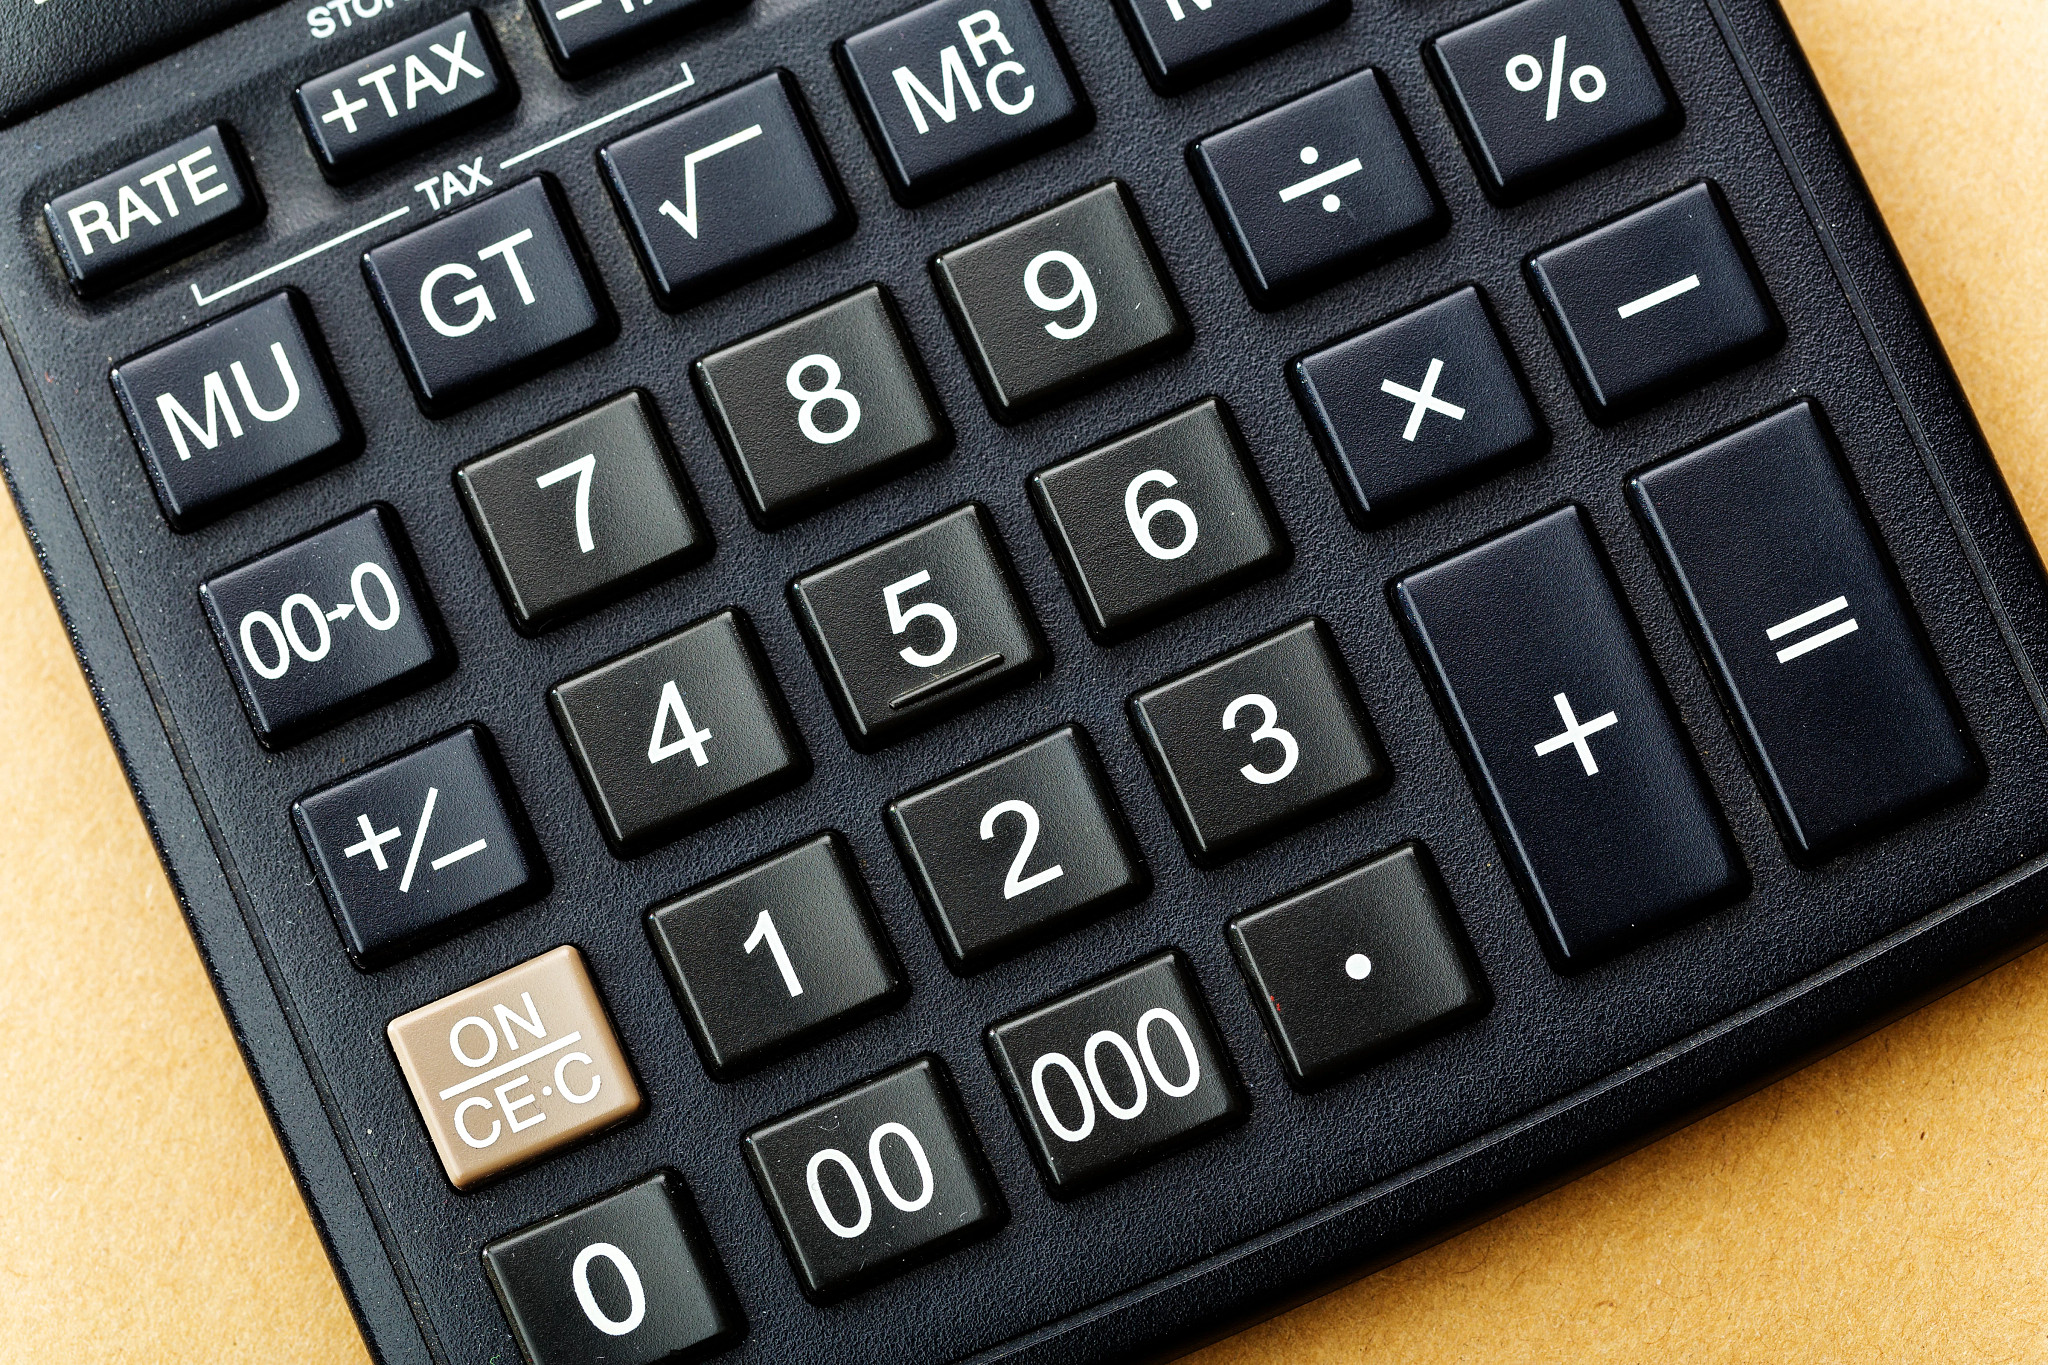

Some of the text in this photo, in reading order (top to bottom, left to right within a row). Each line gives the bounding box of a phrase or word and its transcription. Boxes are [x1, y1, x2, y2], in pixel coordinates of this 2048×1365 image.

[321, 30, 485, 135] +TAX
[67, 144, 229, 257] RATE
[413, 155, 494, 212] TAX
[419, 227, 537, 339] GT
[1023, 250, 1098, 340] 9
[155, 341, 302, 461] MU
[786, 353, 861, 445] 8
[535, 453, 597, 554] 7
[1124, 469, 1199, 560] 6
[882, 569, 958, 668] 5
[647, 680, 713, 768] 4
[1222, 693, 1300, 785] 3
[979, 799, 1064, 900] 2
[743, 909, 804, 998] 1
[448, 991, 547, 1069] ON
[1031, 1007, 1201, 1142] 000
[805, 1121, 936, 1240] 00
[572, 1242, 646, 1336] 0
